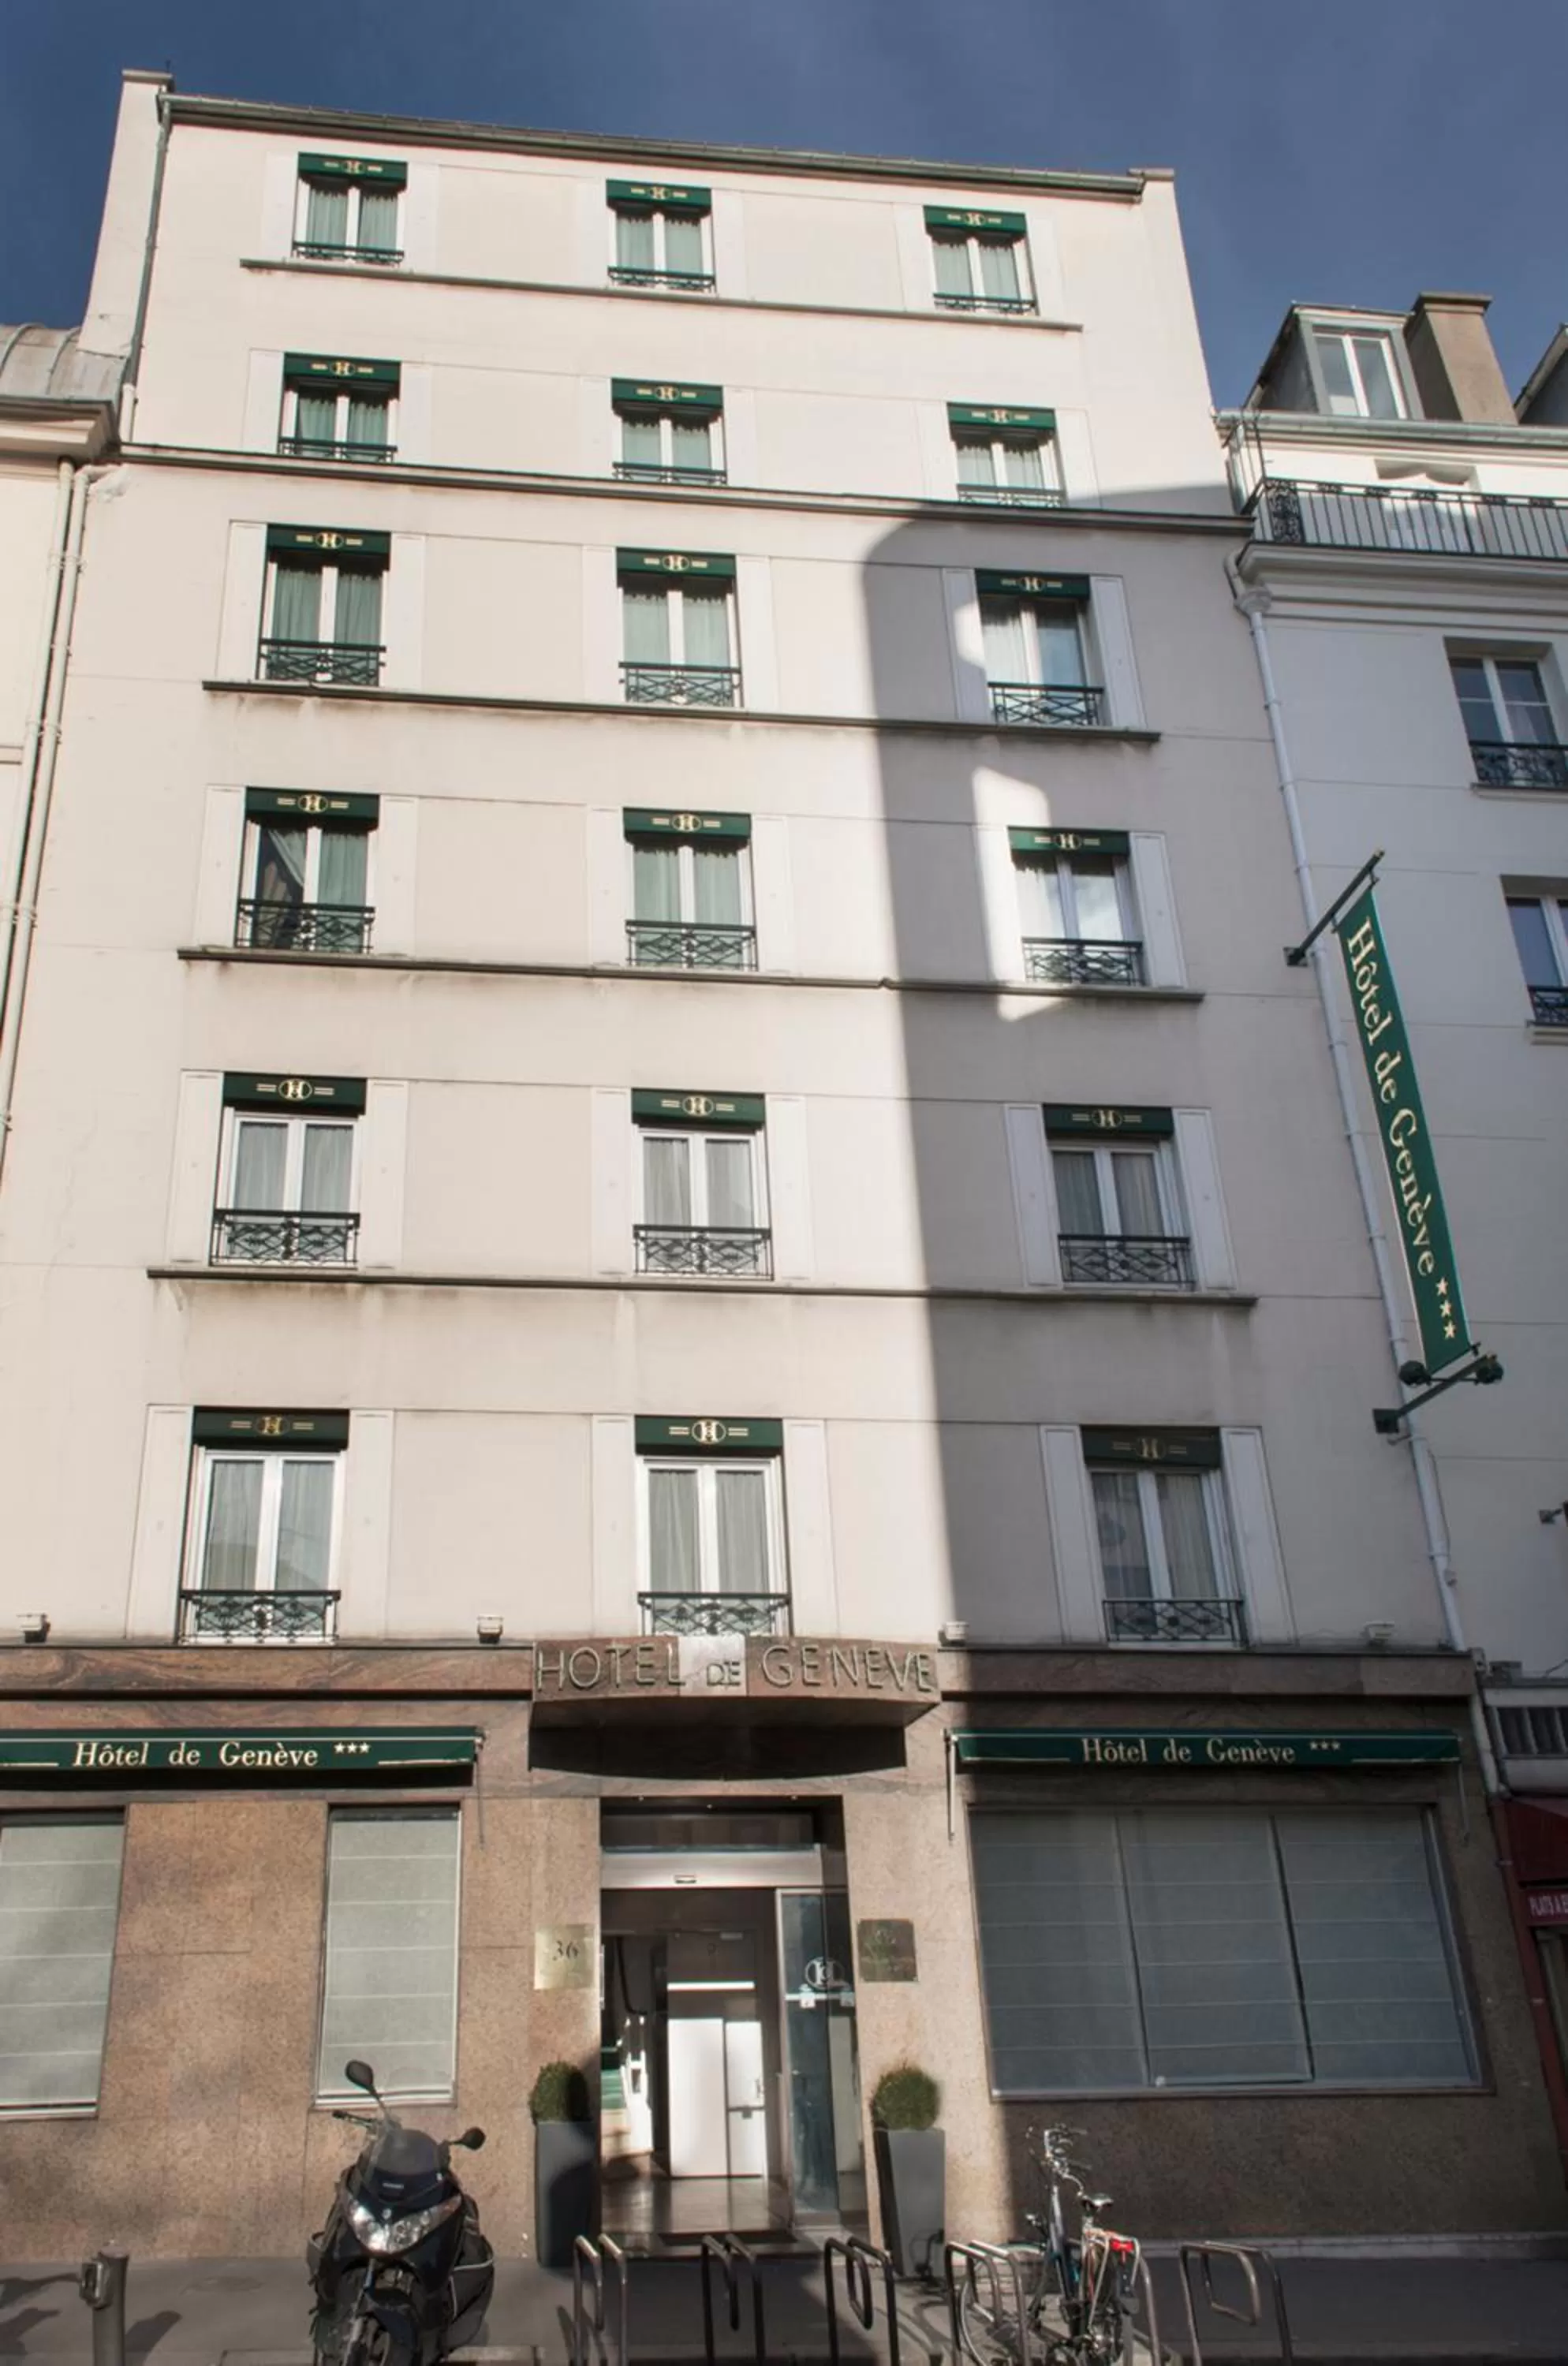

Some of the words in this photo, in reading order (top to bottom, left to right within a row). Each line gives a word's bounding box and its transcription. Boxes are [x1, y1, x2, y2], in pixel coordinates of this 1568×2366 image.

[1347, 917, 1394, 1045] Hôtel
[1374, 1051, 1402, 1104] de
[1387, 1108, 1435, 1276] Genève
[536, 1642, 686, 1692] HOTEL
[706, 1660, 741, 1687] DE
[762, 1643, 934, 1692] GENEVE
[73, 1741, 150, 1767] Hôtel
[168, 1741, 201, 1767] de
[218, 1741, 319, 1767] Genève
[1081, 1737, 1148, 1763] Hôtel
[1163, 1739, 1193, 1763] de
[1206, 1739, 1296, 1763] Genève
[552, 1940, 581, 1961] 36
